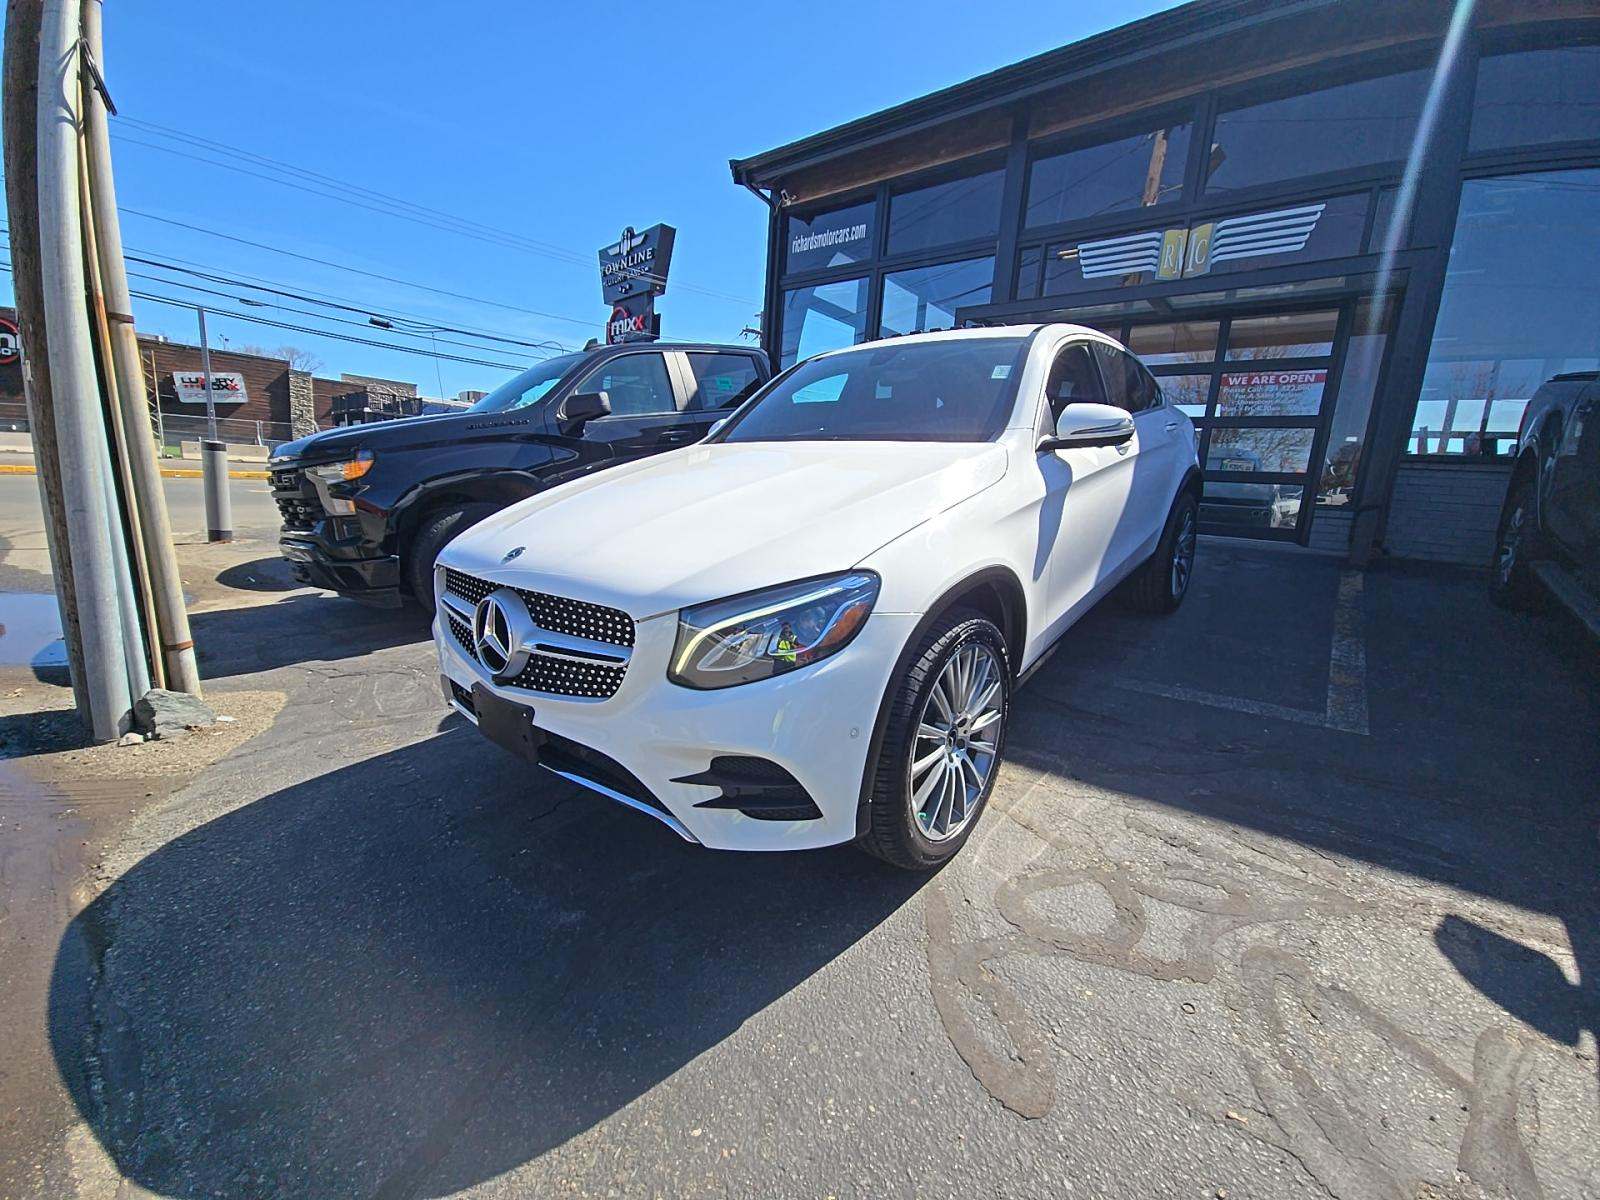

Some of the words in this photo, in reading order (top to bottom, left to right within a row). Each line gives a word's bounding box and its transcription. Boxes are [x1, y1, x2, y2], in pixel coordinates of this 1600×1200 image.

[792, 223, 867, 253] richardsmotorcars.com
[602, 247, 653, 277] TOWNLINE
[1228, 377, 1248, 385] WE
[1251, 375, 1276, 384] ARE
[1279, 374, 1315, 383] OPEN
